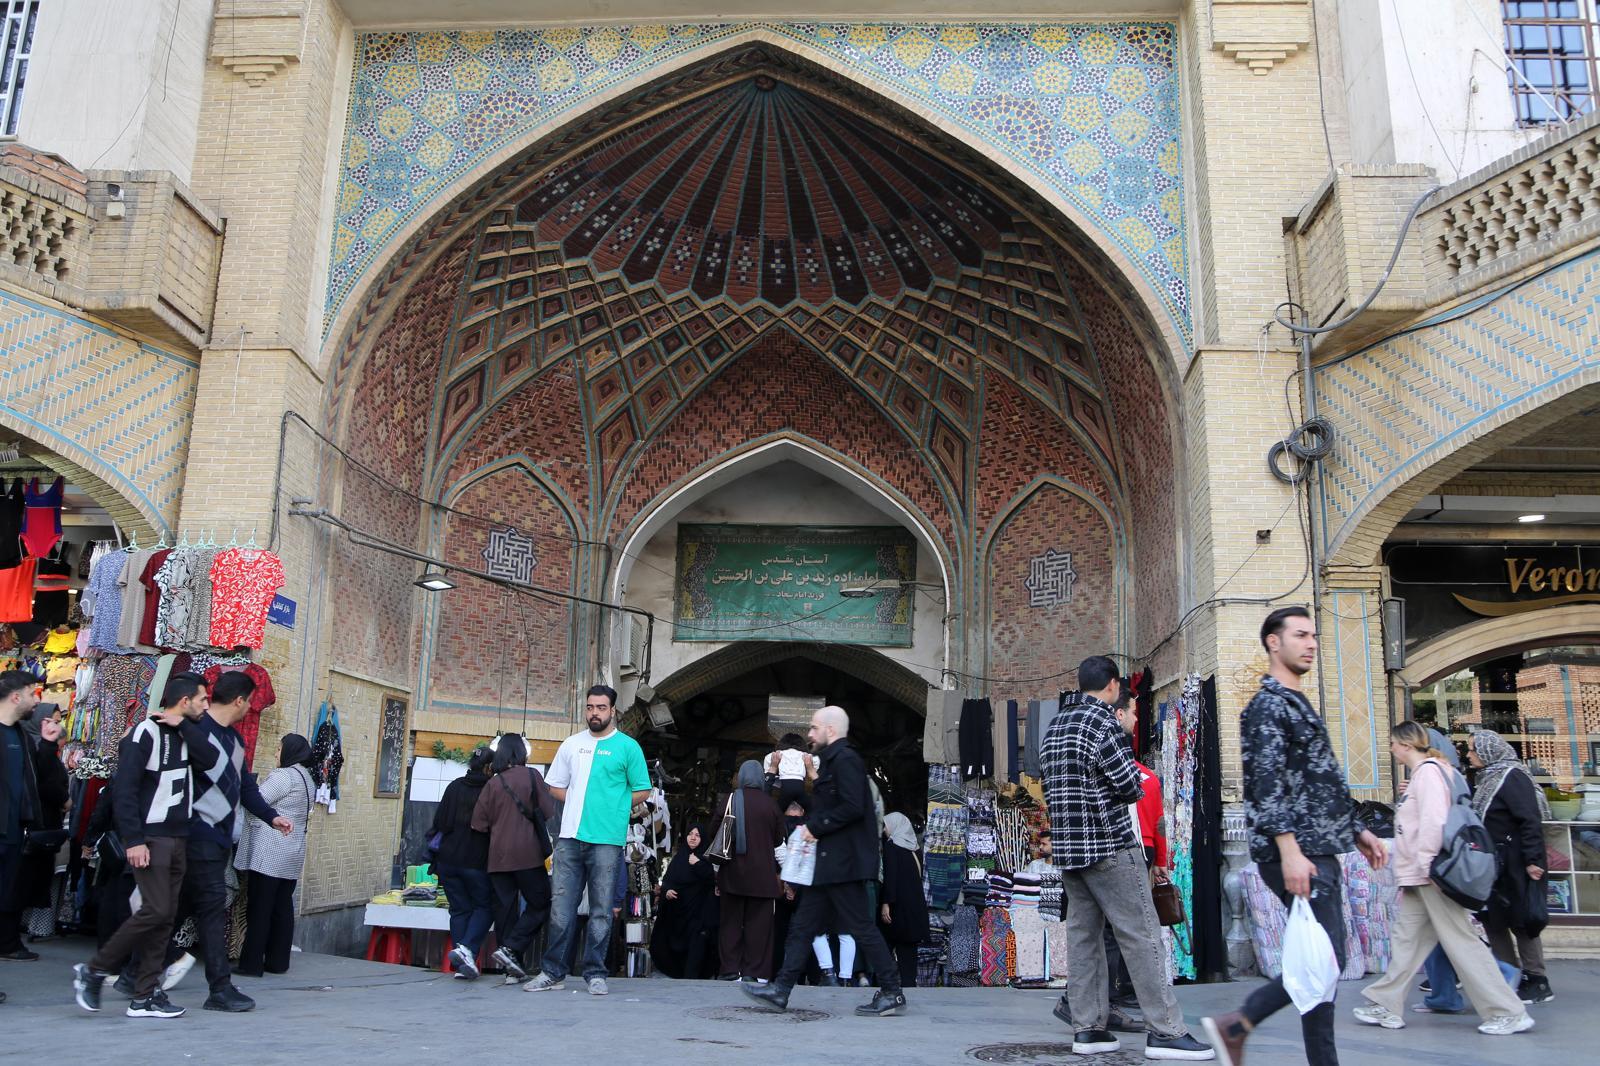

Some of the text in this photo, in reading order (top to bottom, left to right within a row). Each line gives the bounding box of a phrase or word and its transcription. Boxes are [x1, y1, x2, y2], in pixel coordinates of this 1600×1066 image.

[761, 554, 829, 566] آستان مقدس
[711, 568, 753, 585] الحسین
[754, 572, 769, 586] بن
[770, 569, 793, 586] علی
[795, 573, 810, 586] بن
